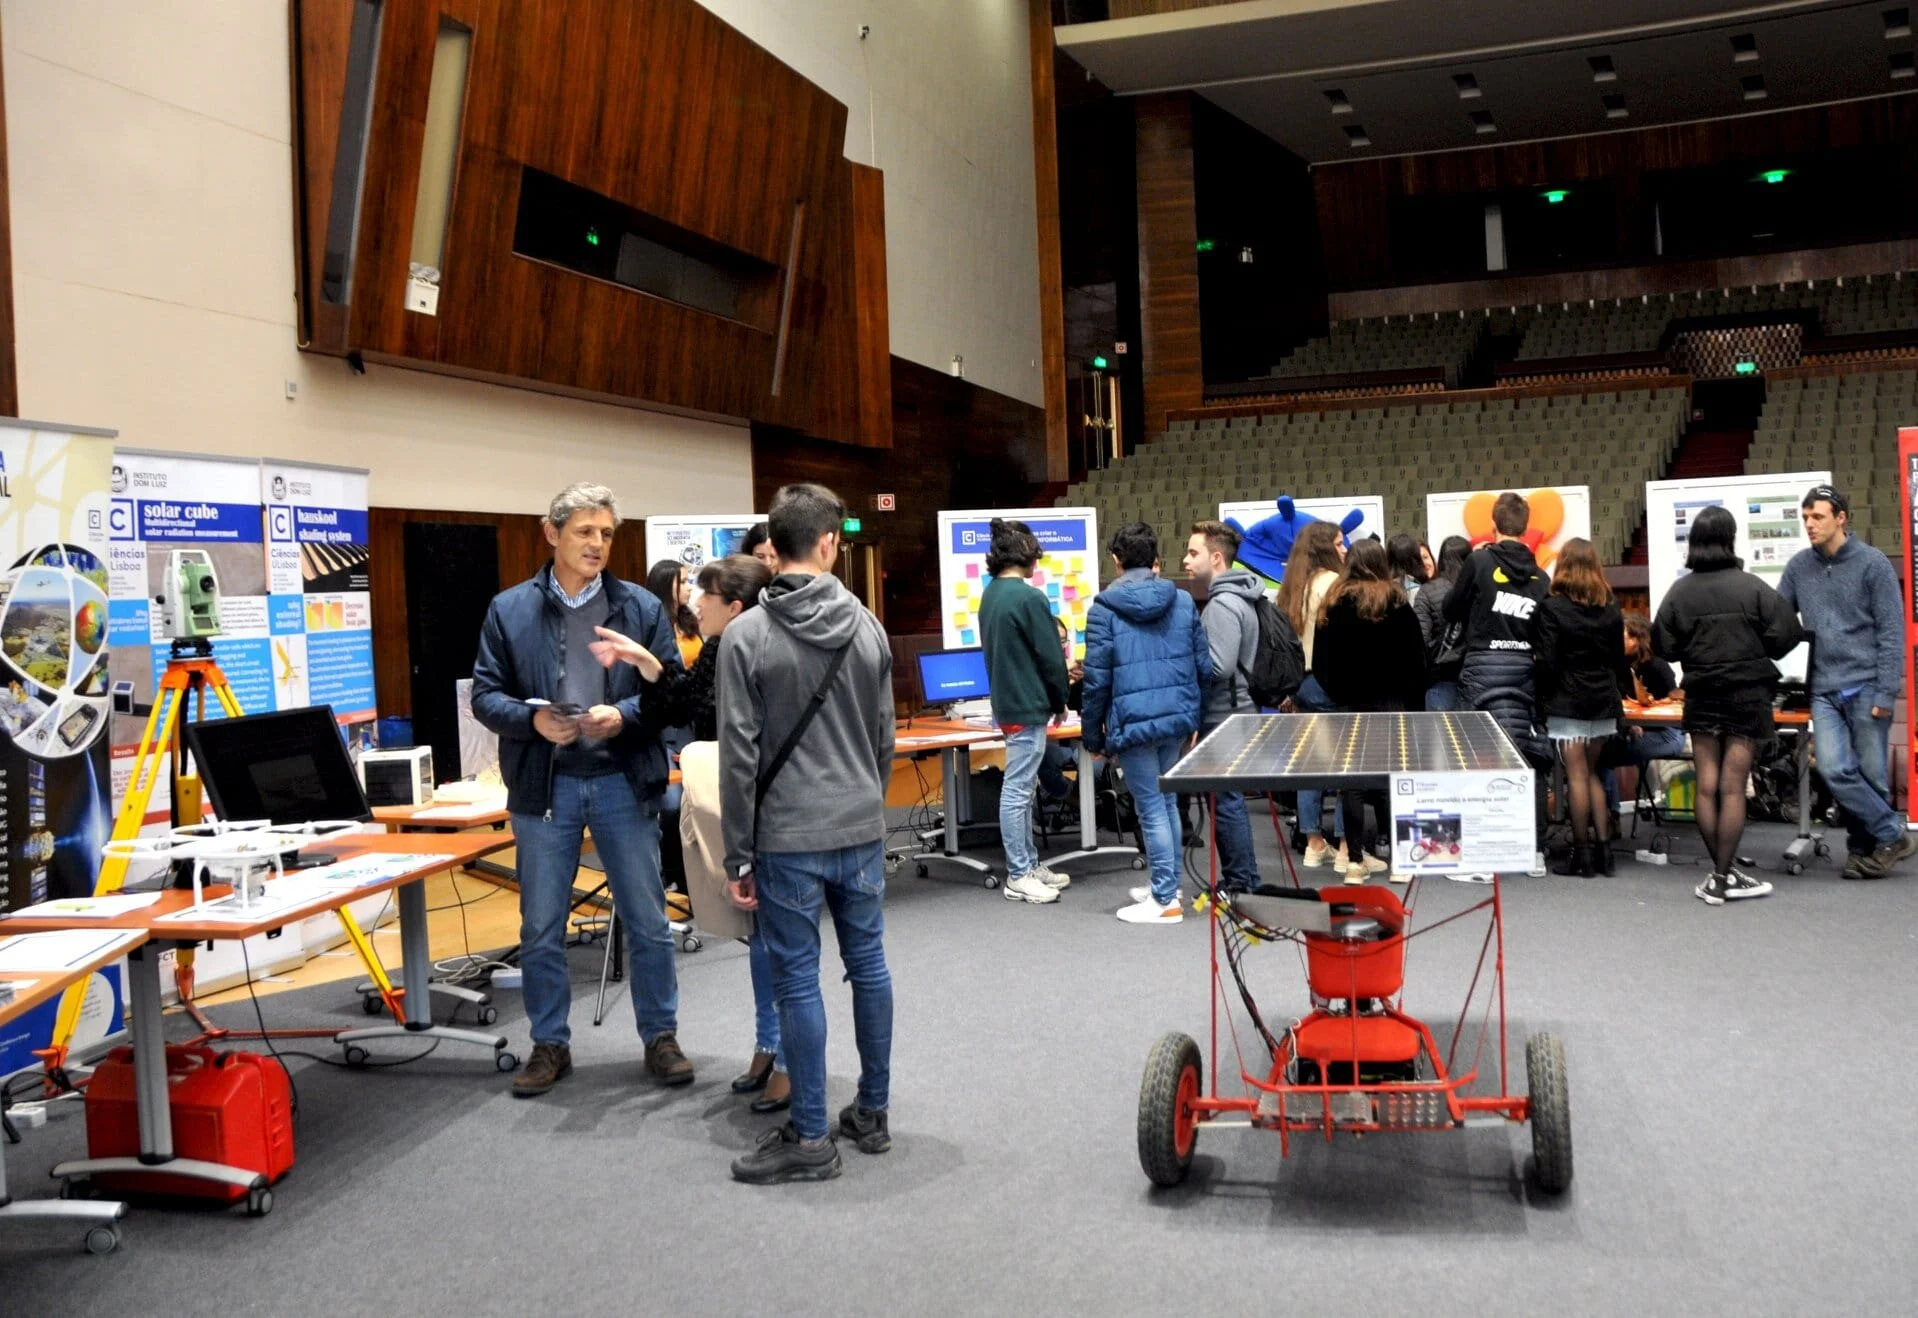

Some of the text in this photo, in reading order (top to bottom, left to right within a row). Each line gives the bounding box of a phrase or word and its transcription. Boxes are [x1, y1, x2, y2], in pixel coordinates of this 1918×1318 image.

[133, 472, 167, 481] INSTITUTO
[133, 480, 168, 488] DOM LUIZ
[143, 501, 219, 520] solar cube
[144, 528, 163, 537] solar
[298, 528, 352, 544] shading system
[110, 547, 146, 559] iências
[110, 561, 142, 571] Lisboa
